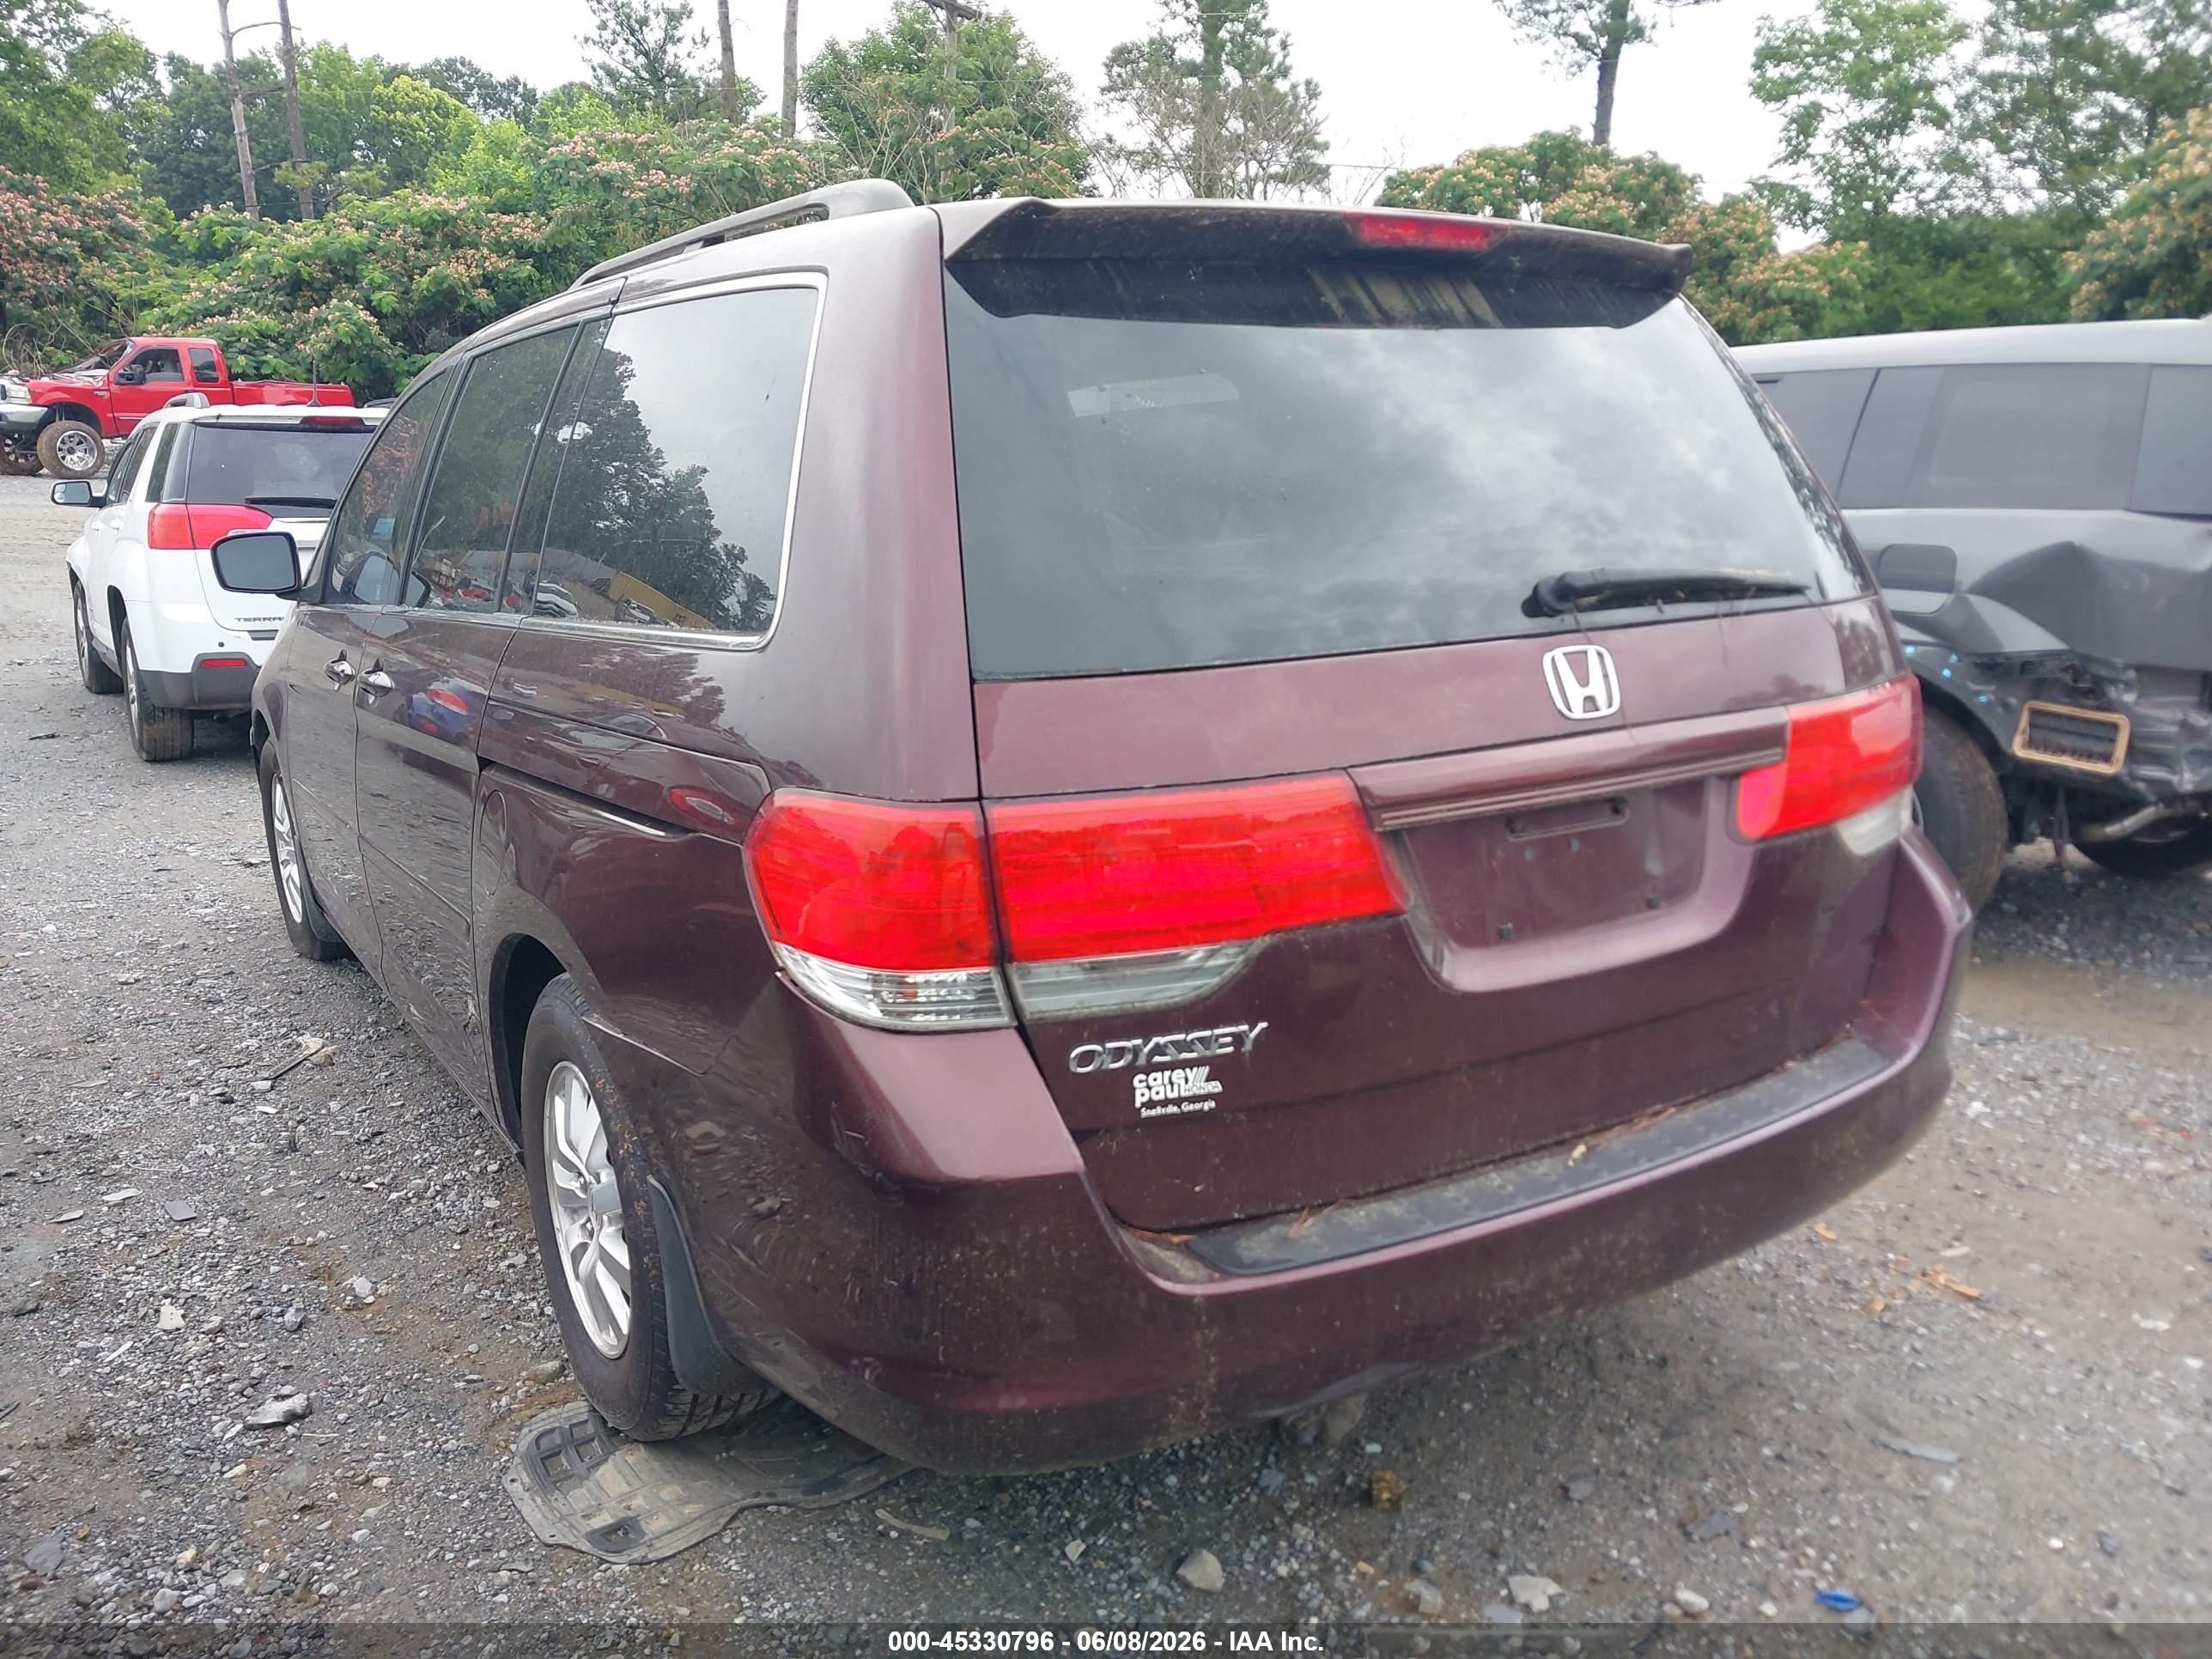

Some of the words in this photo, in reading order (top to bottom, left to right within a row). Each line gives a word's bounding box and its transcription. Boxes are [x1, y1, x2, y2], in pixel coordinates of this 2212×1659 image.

[1069, 1022, 1269, 1073] ODYSSEY
[1133, 1065, 1210, 1088] carey
[1134, 1083, 1188, 1109] paul
[1184, 1081, 1222, 1095] HONDA
[1181, 1099, 1216, 1112] Georgia
